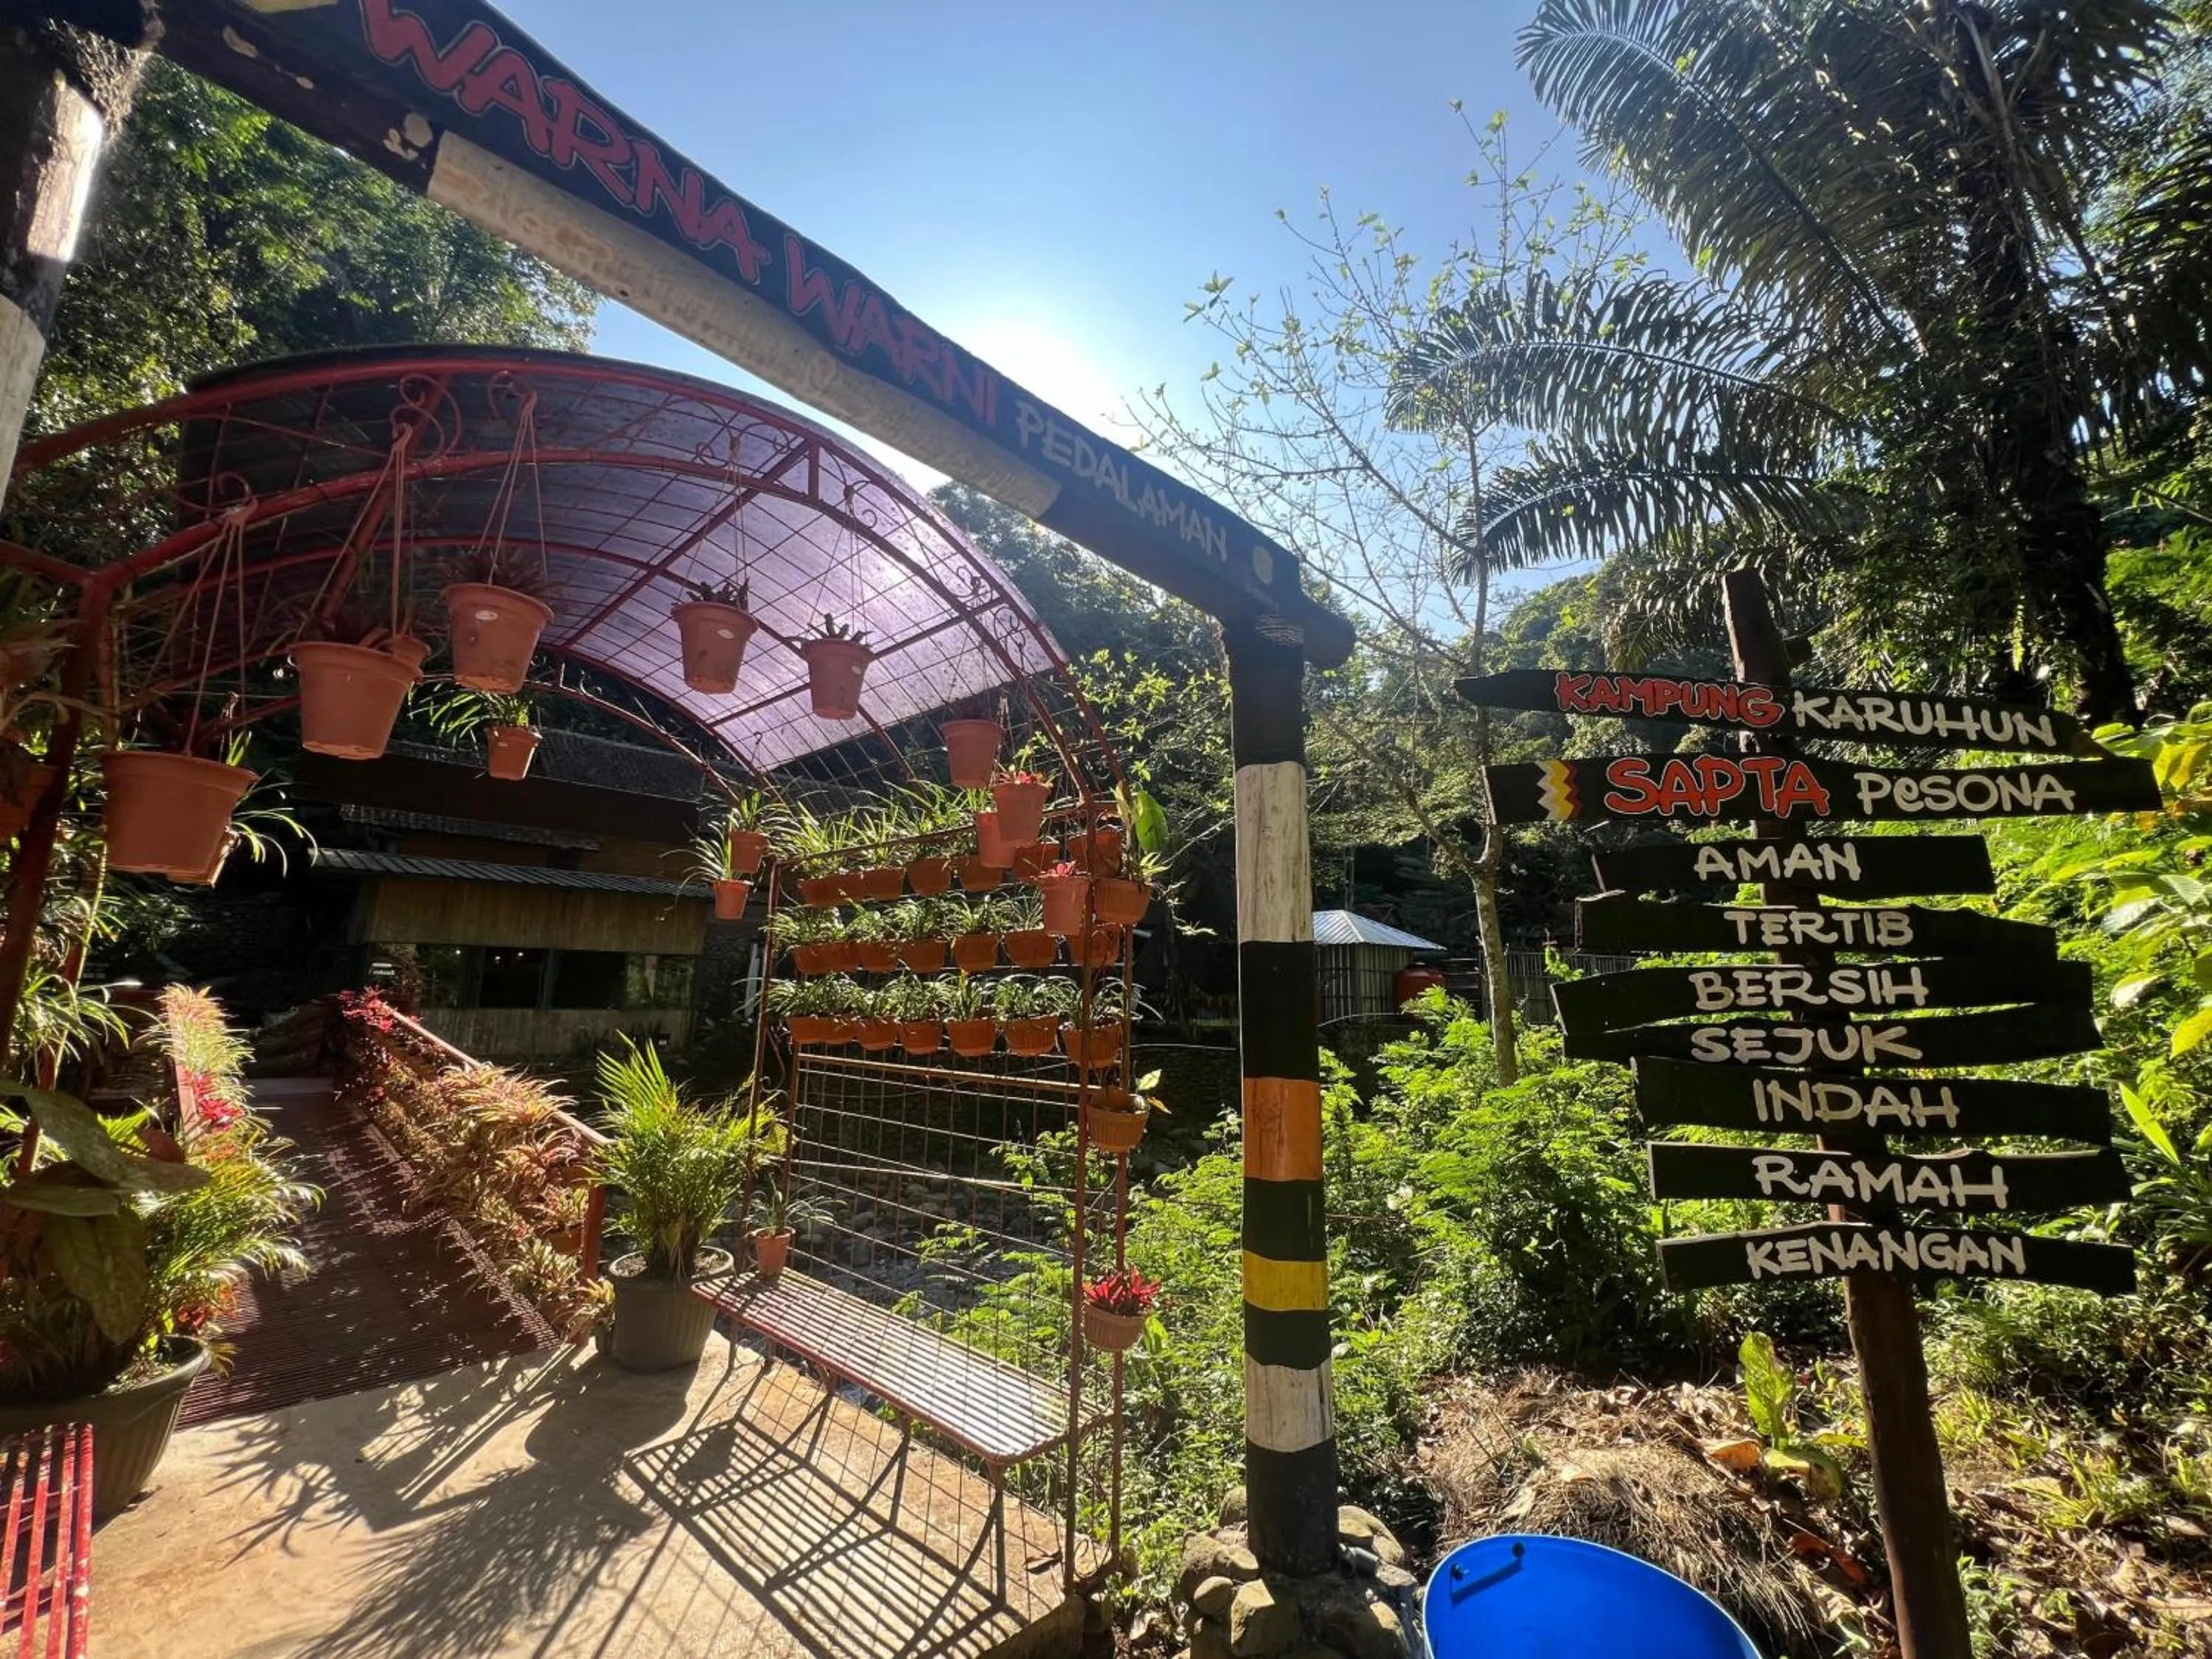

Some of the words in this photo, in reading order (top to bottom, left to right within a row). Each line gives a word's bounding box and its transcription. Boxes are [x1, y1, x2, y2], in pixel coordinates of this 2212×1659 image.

[360, 0, 771, 286] WARNA
[785, 232, 1000, 428] WARNI
[1015, 399, 1228, 564] PEDALAMAN
[1554, 672, 1784, 728] KAMPUNG
[1792, 690, 2057, 748] KARUHUN
[1604, 757, 1830, 818] SAPTA
[1694, 842, 1862, 883] AMAN
[1724, 910, 1914, 947] TERTIB
[1688, 967, 1930, 1012] BERSIH
[1691, 1025, 1924, 1065] SEJUK
[1753, 1079, 1961, 1129] INDAH
[1754, 1155, 2009, 1209] RAMAH
[1745, 1229, 2027, 1279] KENANGAN
